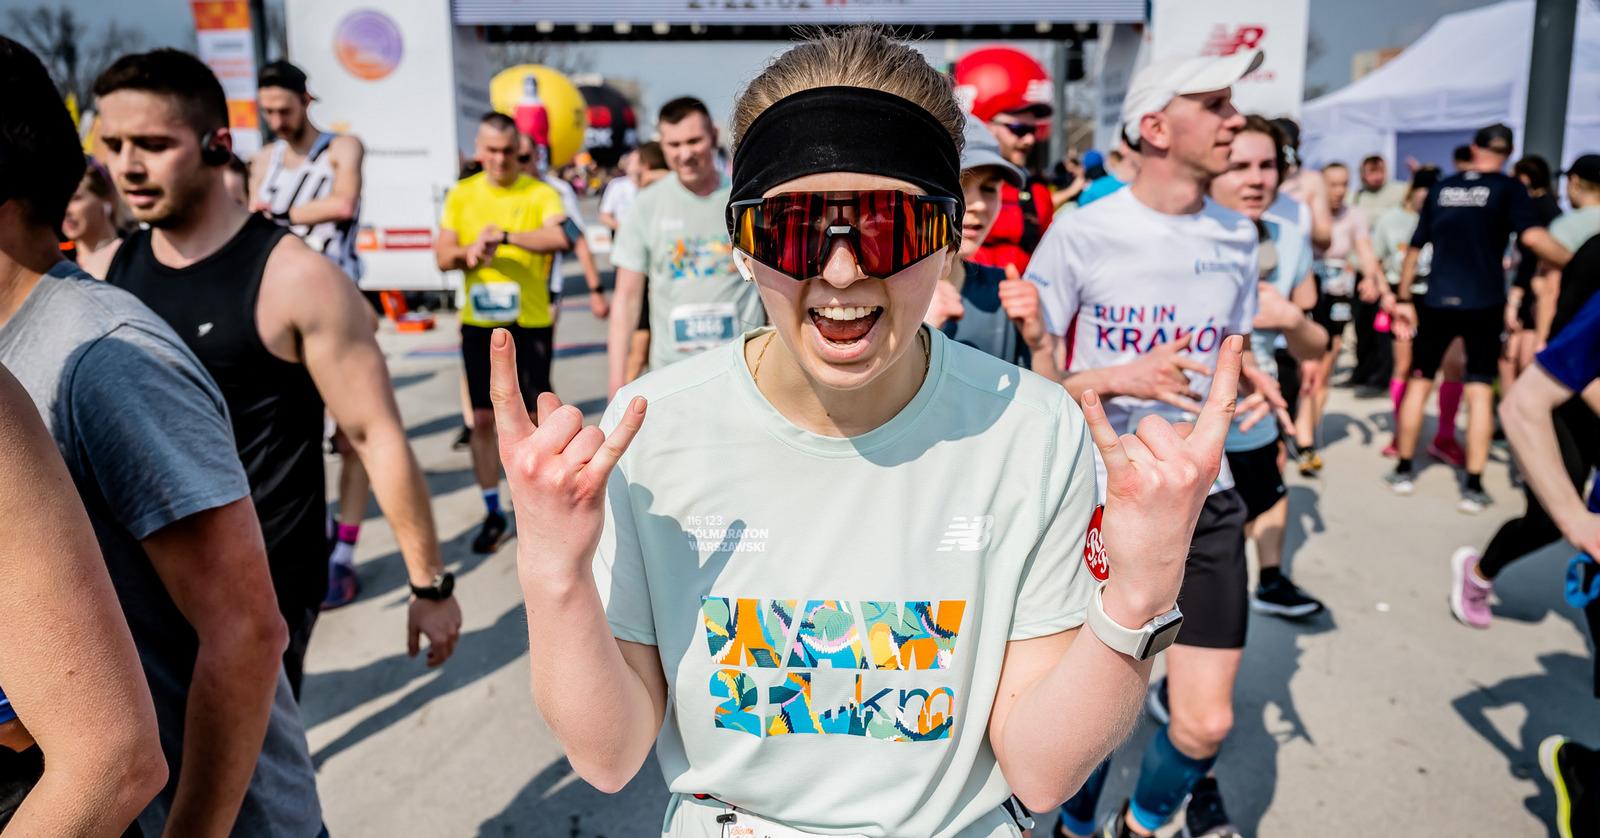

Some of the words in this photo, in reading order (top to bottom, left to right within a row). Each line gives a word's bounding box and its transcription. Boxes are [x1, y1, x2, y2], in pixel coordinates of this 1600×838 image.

[1094, 303, 1145, 324] RUN
[1153, 304, 1175, 323] IN
[1097, 316, 1226, 353] KRAKÓ
[689, 541, 765, 553] WARSZAWSKI
[701, 595, 967, 671] WAW
